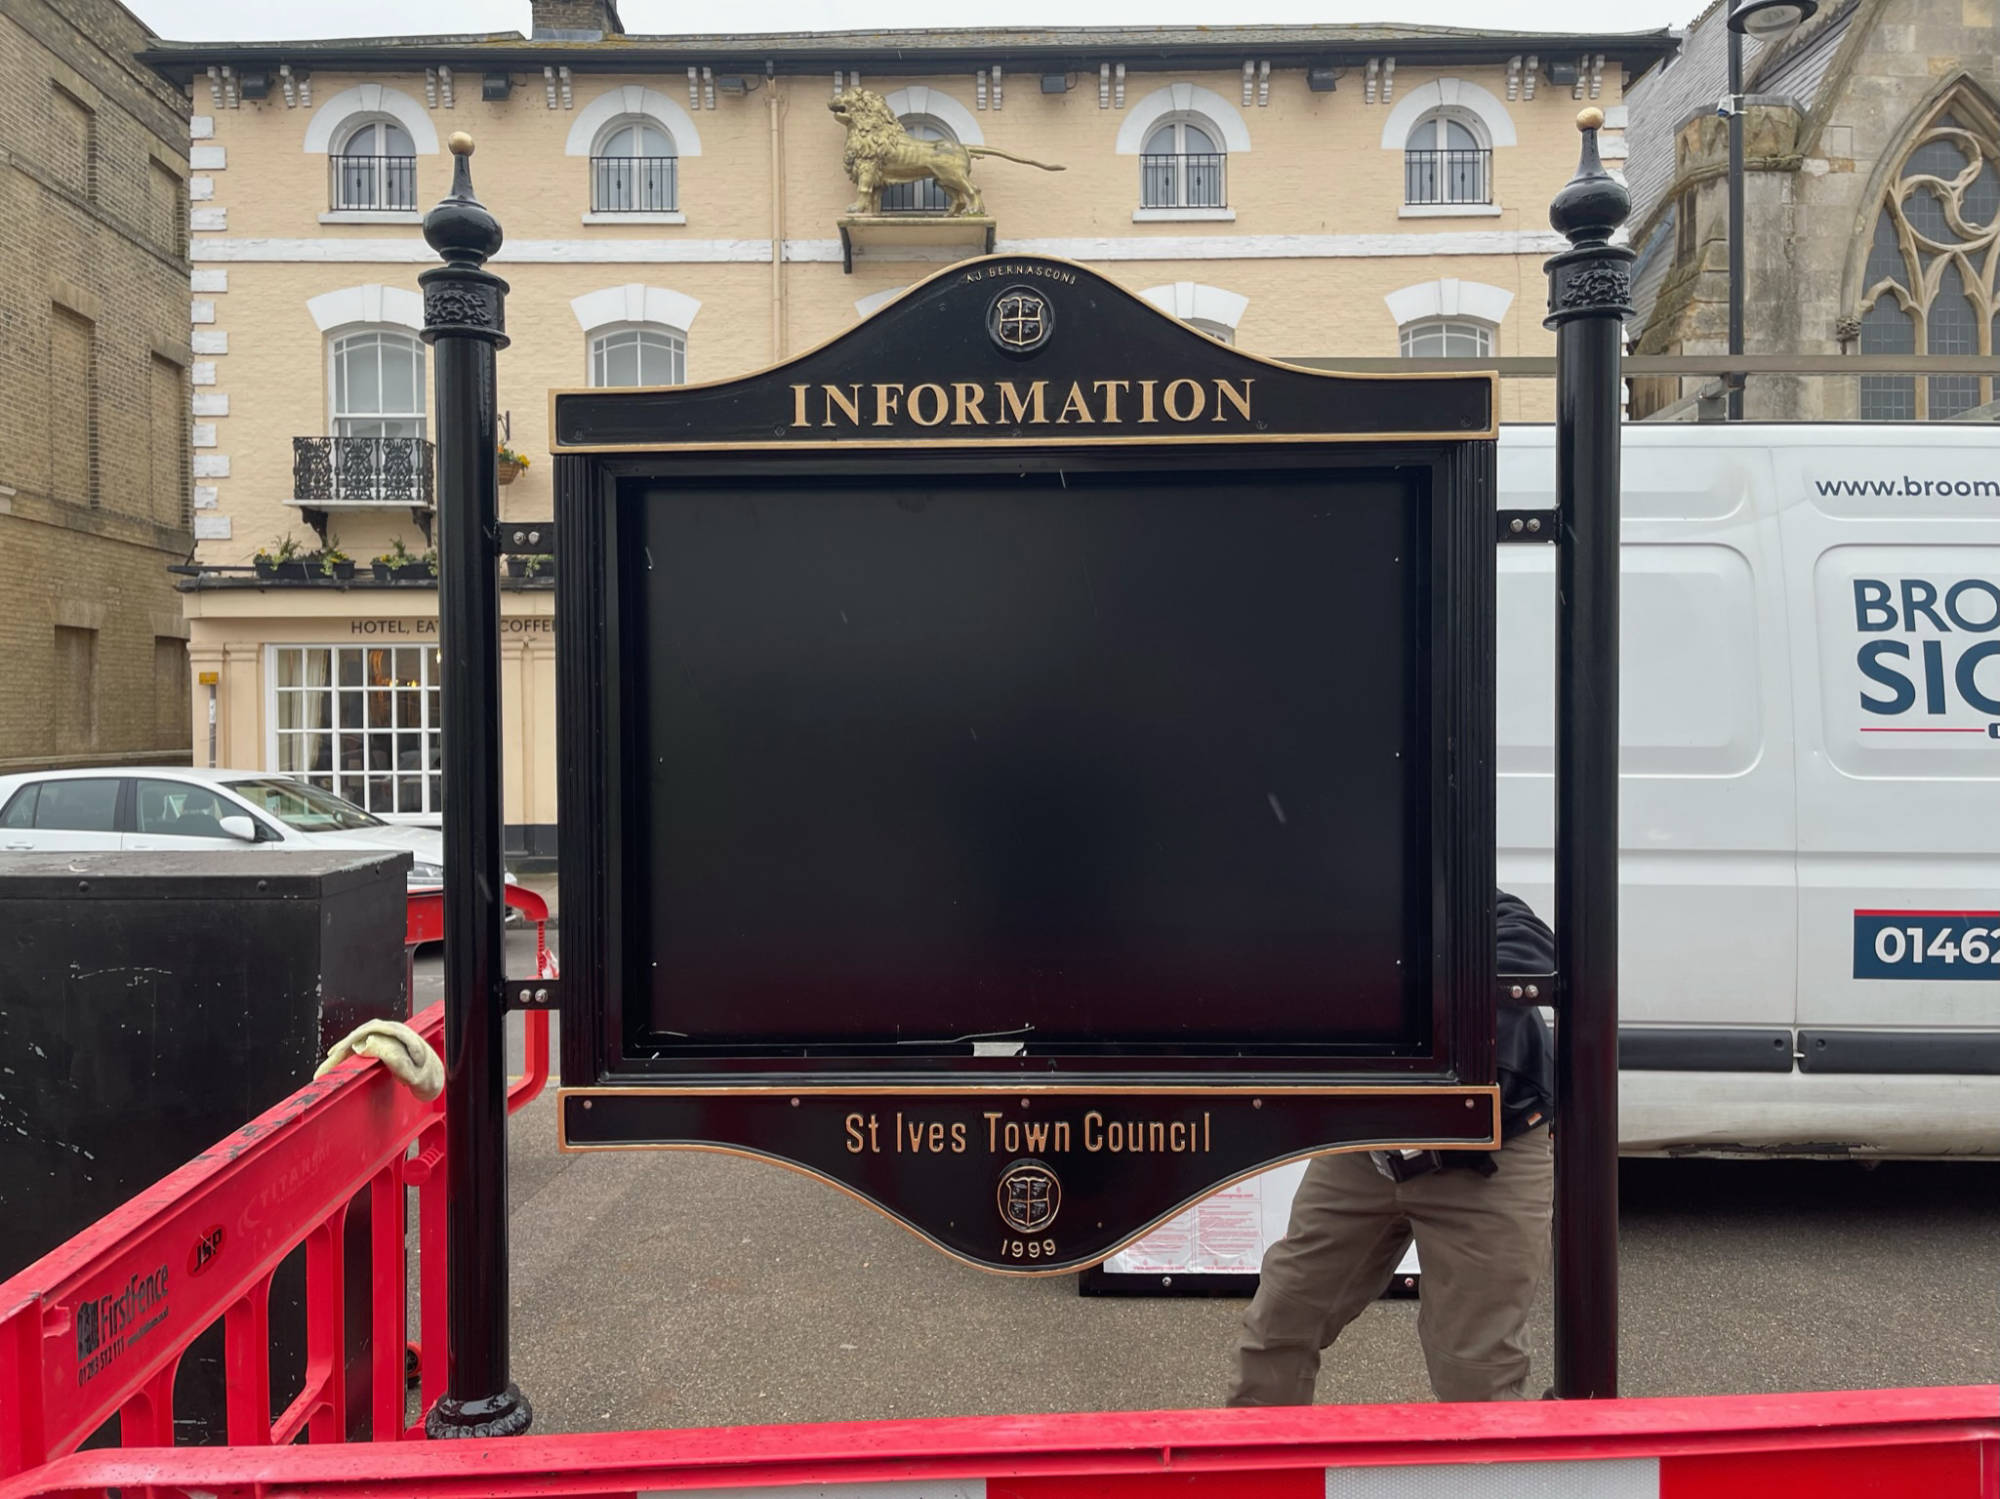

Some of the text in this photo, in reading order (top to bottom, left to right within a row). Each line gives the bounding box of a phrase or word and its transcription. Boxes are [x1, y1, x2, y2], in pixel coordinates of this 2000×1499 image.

[988, 264, 1077, 285] BERNASCONI
[790, 378, 1256, 427] INFORMATION
[1853, 578, 2000, 632] BRO
[351, 620, 410, 635] HOTEL,
[845, 1111, 1210, 1153] St Ives Town Council
[1001, 1239, 1056, 1257] 1999
[101, 1264, 169, 1344] FirstFence
